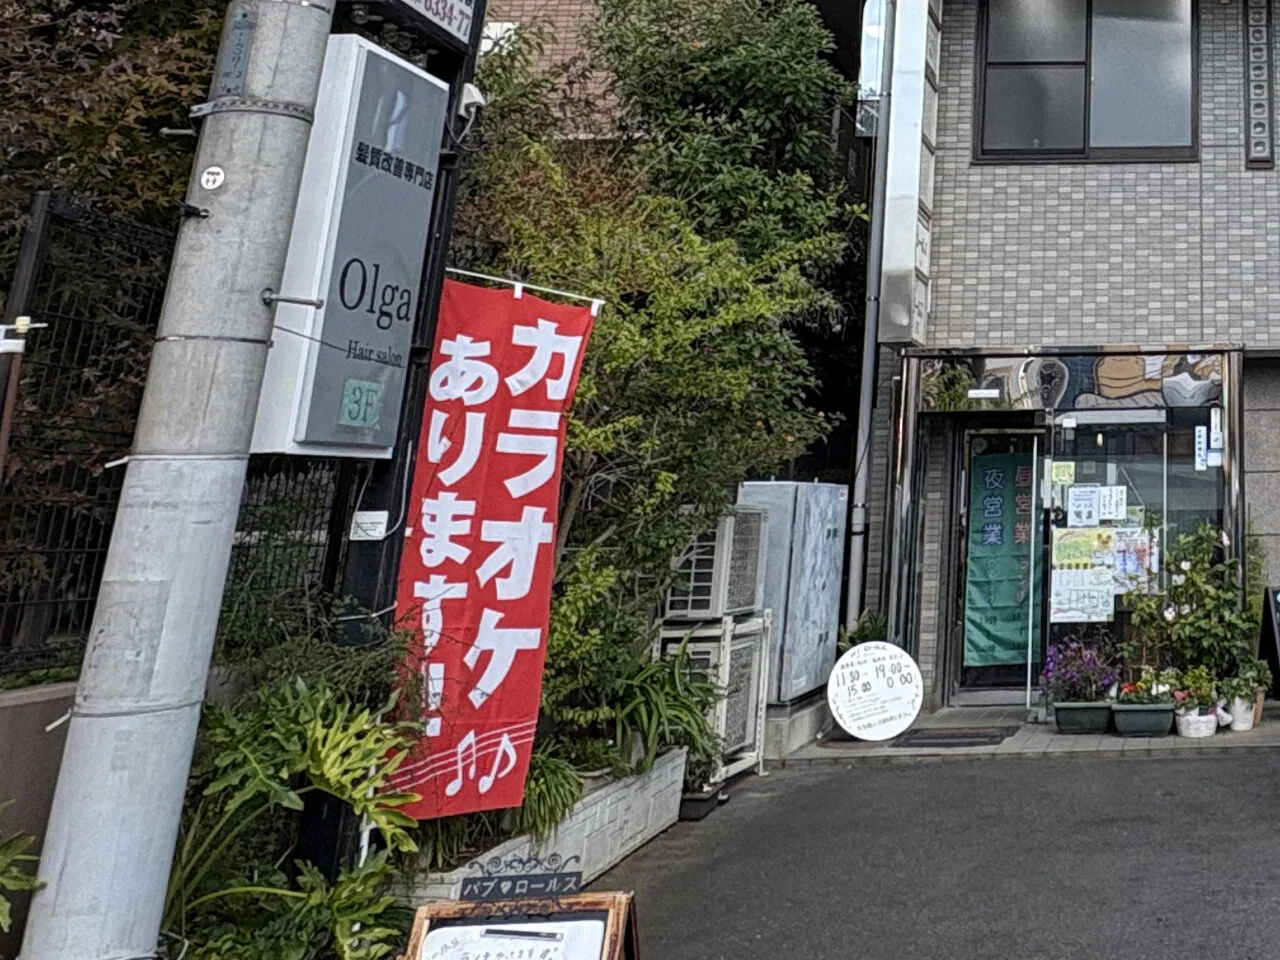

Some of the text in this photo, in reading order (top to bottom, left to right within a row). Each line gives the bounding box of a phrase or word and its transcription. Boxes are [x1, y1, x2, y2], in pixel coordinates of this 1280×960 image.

[355, 141, 435, 191] 髪質改善専門店
[339, 258, 412, 330] Olga
[345, 339, 403, 365] Hair salon
[348, 386, 379, 423] 3F
[463, 318, 583, 710] カラオケ
[982, 468, 1005, 545] 夜営業
